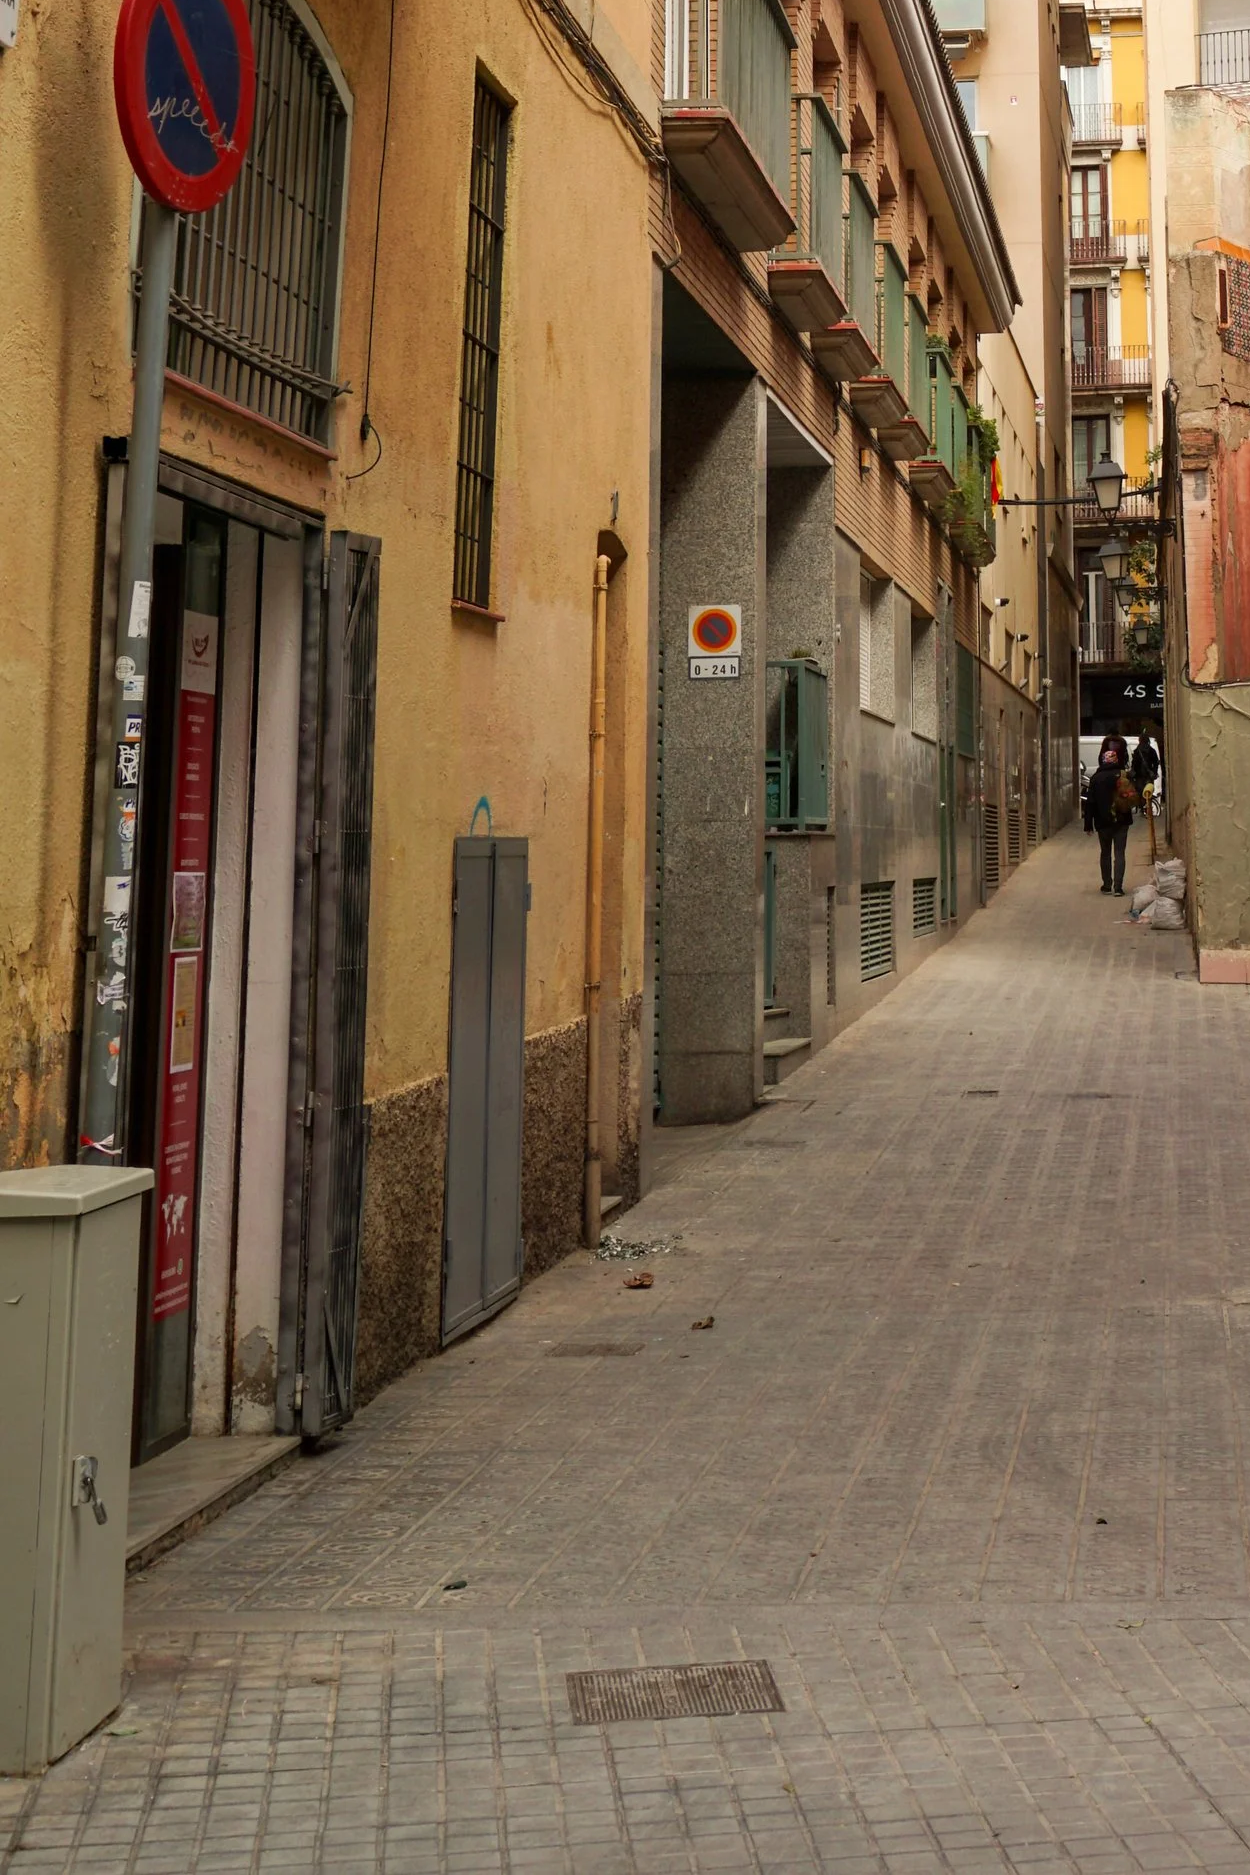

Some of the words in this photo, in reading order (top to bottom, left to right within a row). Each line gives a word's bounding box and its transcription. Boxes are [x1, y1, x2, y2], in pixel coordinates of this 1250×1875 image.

[694, 665, 700, 675] 0
[712, 664, 725, 674] 24
[730, 664, 736, 674] h
[1123, 684, 1147, 698] 4S
